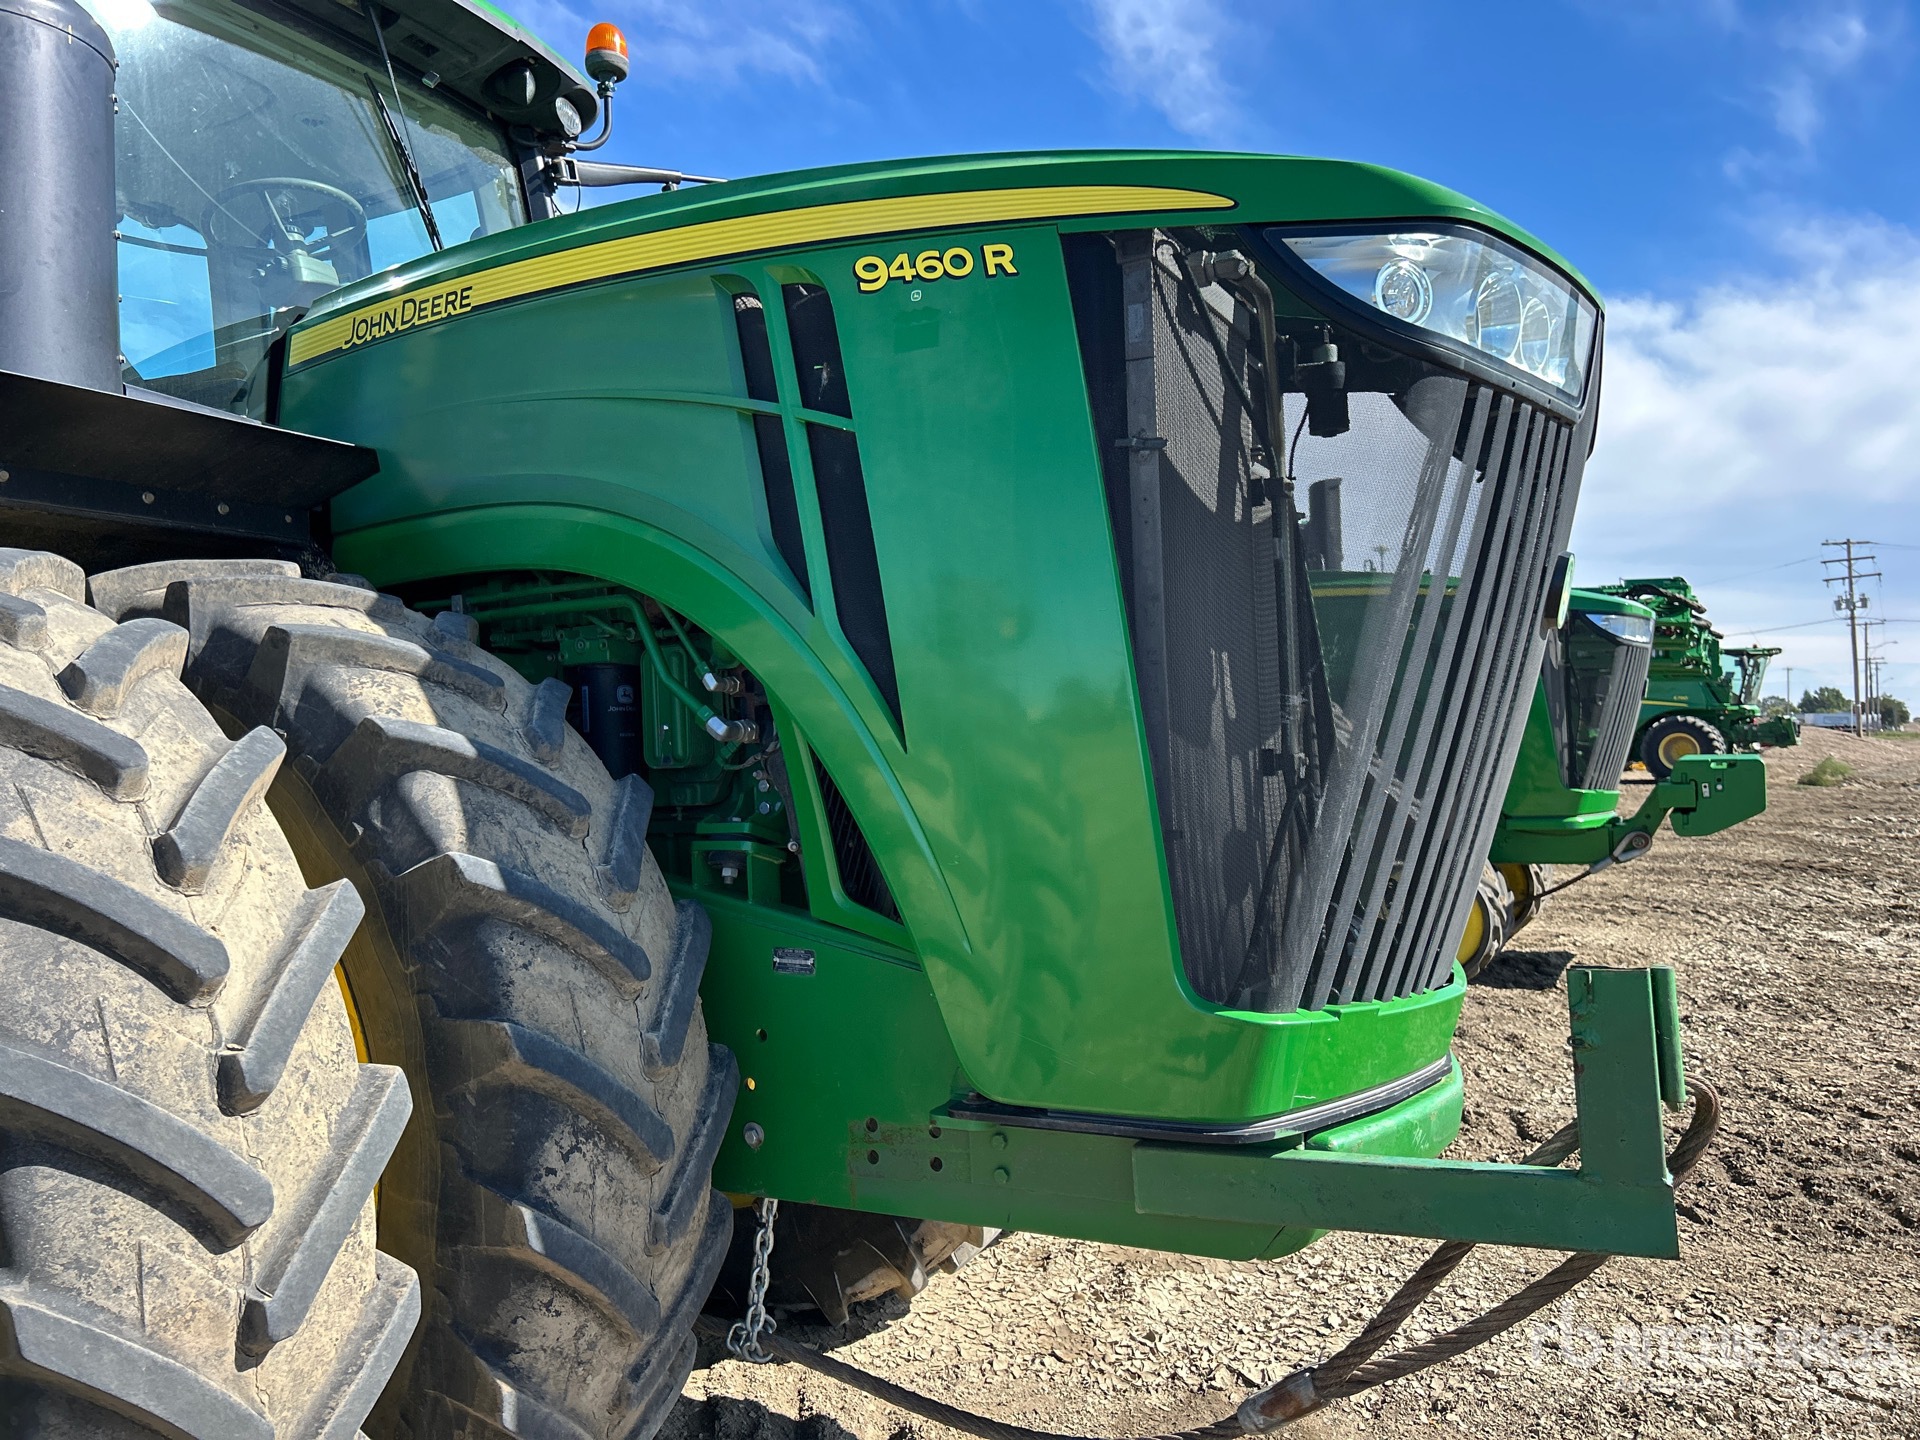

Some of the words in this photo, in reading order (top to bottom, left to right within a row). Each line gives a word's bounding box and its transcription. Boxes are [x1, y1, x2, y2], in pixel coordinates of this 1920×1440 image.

[853, 246, 974, 293] 9460
[981, 243, 1019, 277] R
[343, 307, 398, 347] JOHN
[400, 285, 473, 328] DEERE
